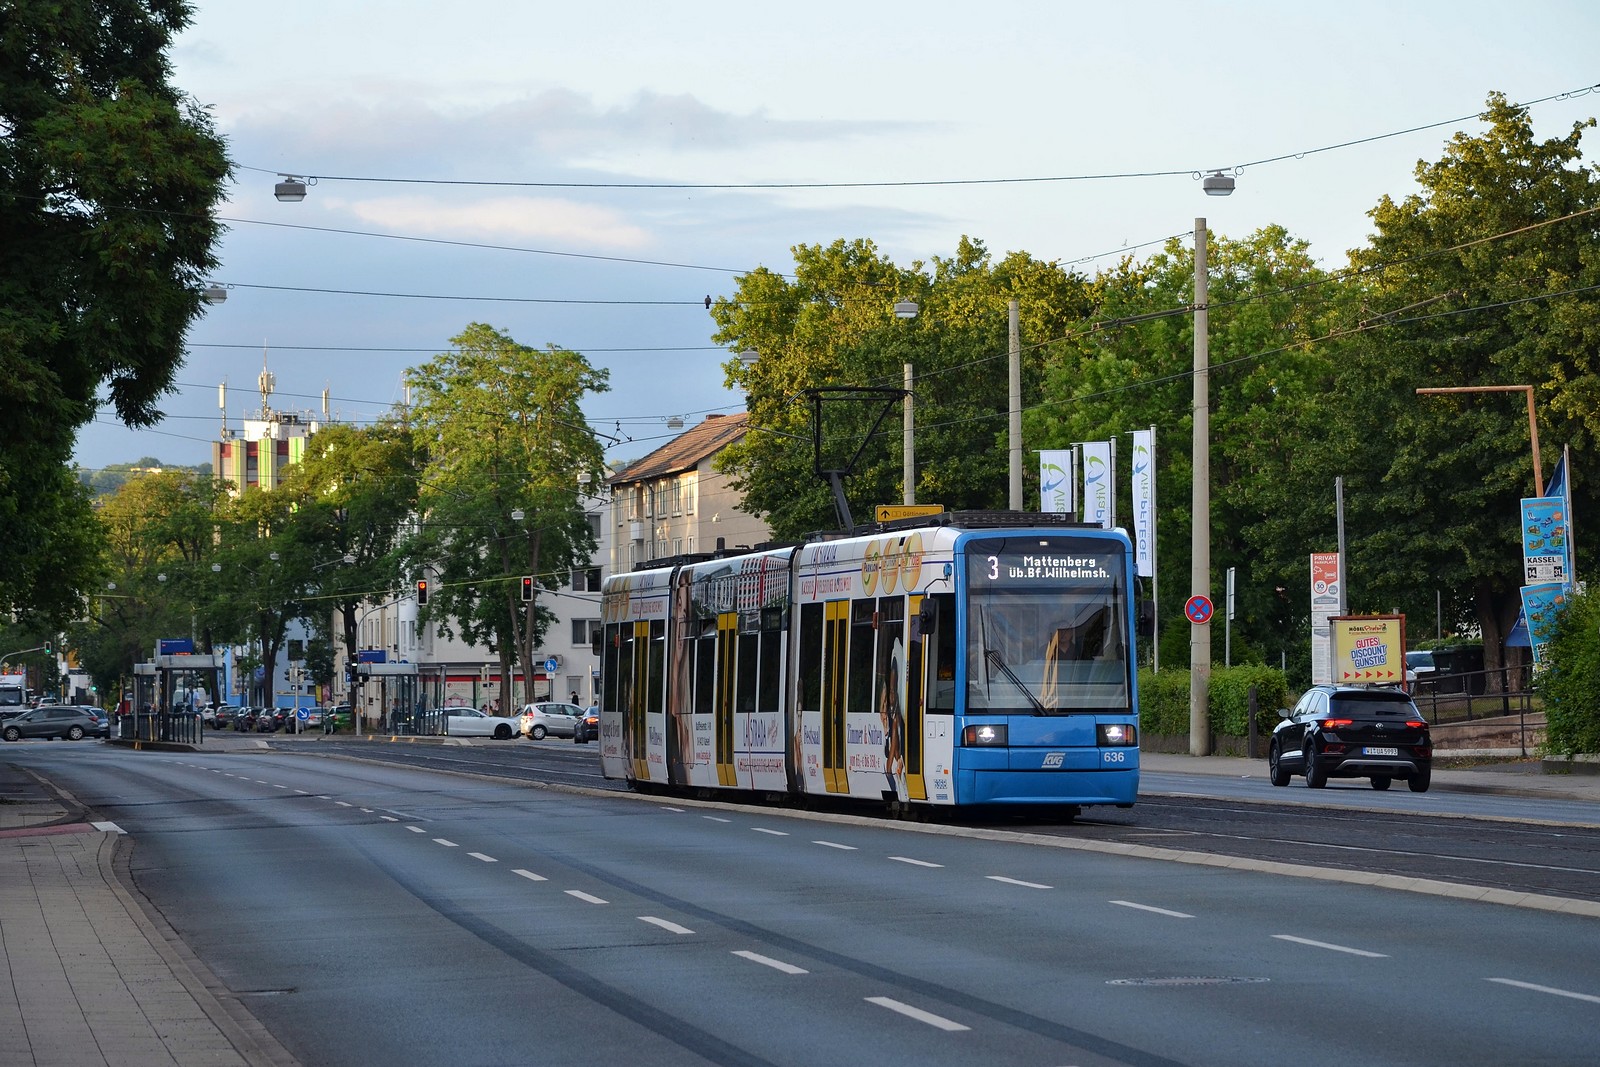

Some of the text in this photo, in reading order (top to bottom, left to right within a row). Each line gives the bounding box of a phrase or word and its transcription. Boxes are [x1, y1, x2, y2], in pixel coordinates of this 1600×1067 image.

[1527, 556, 1556, 565] KASSEL
[987, 555, 1096, 580] 3 Mattenberg
[1356, 636, 1379, 649] GUTES
[1350, 644, 1386, 660] DISCOUNT
[1104, 752, 1125, 763] 636
